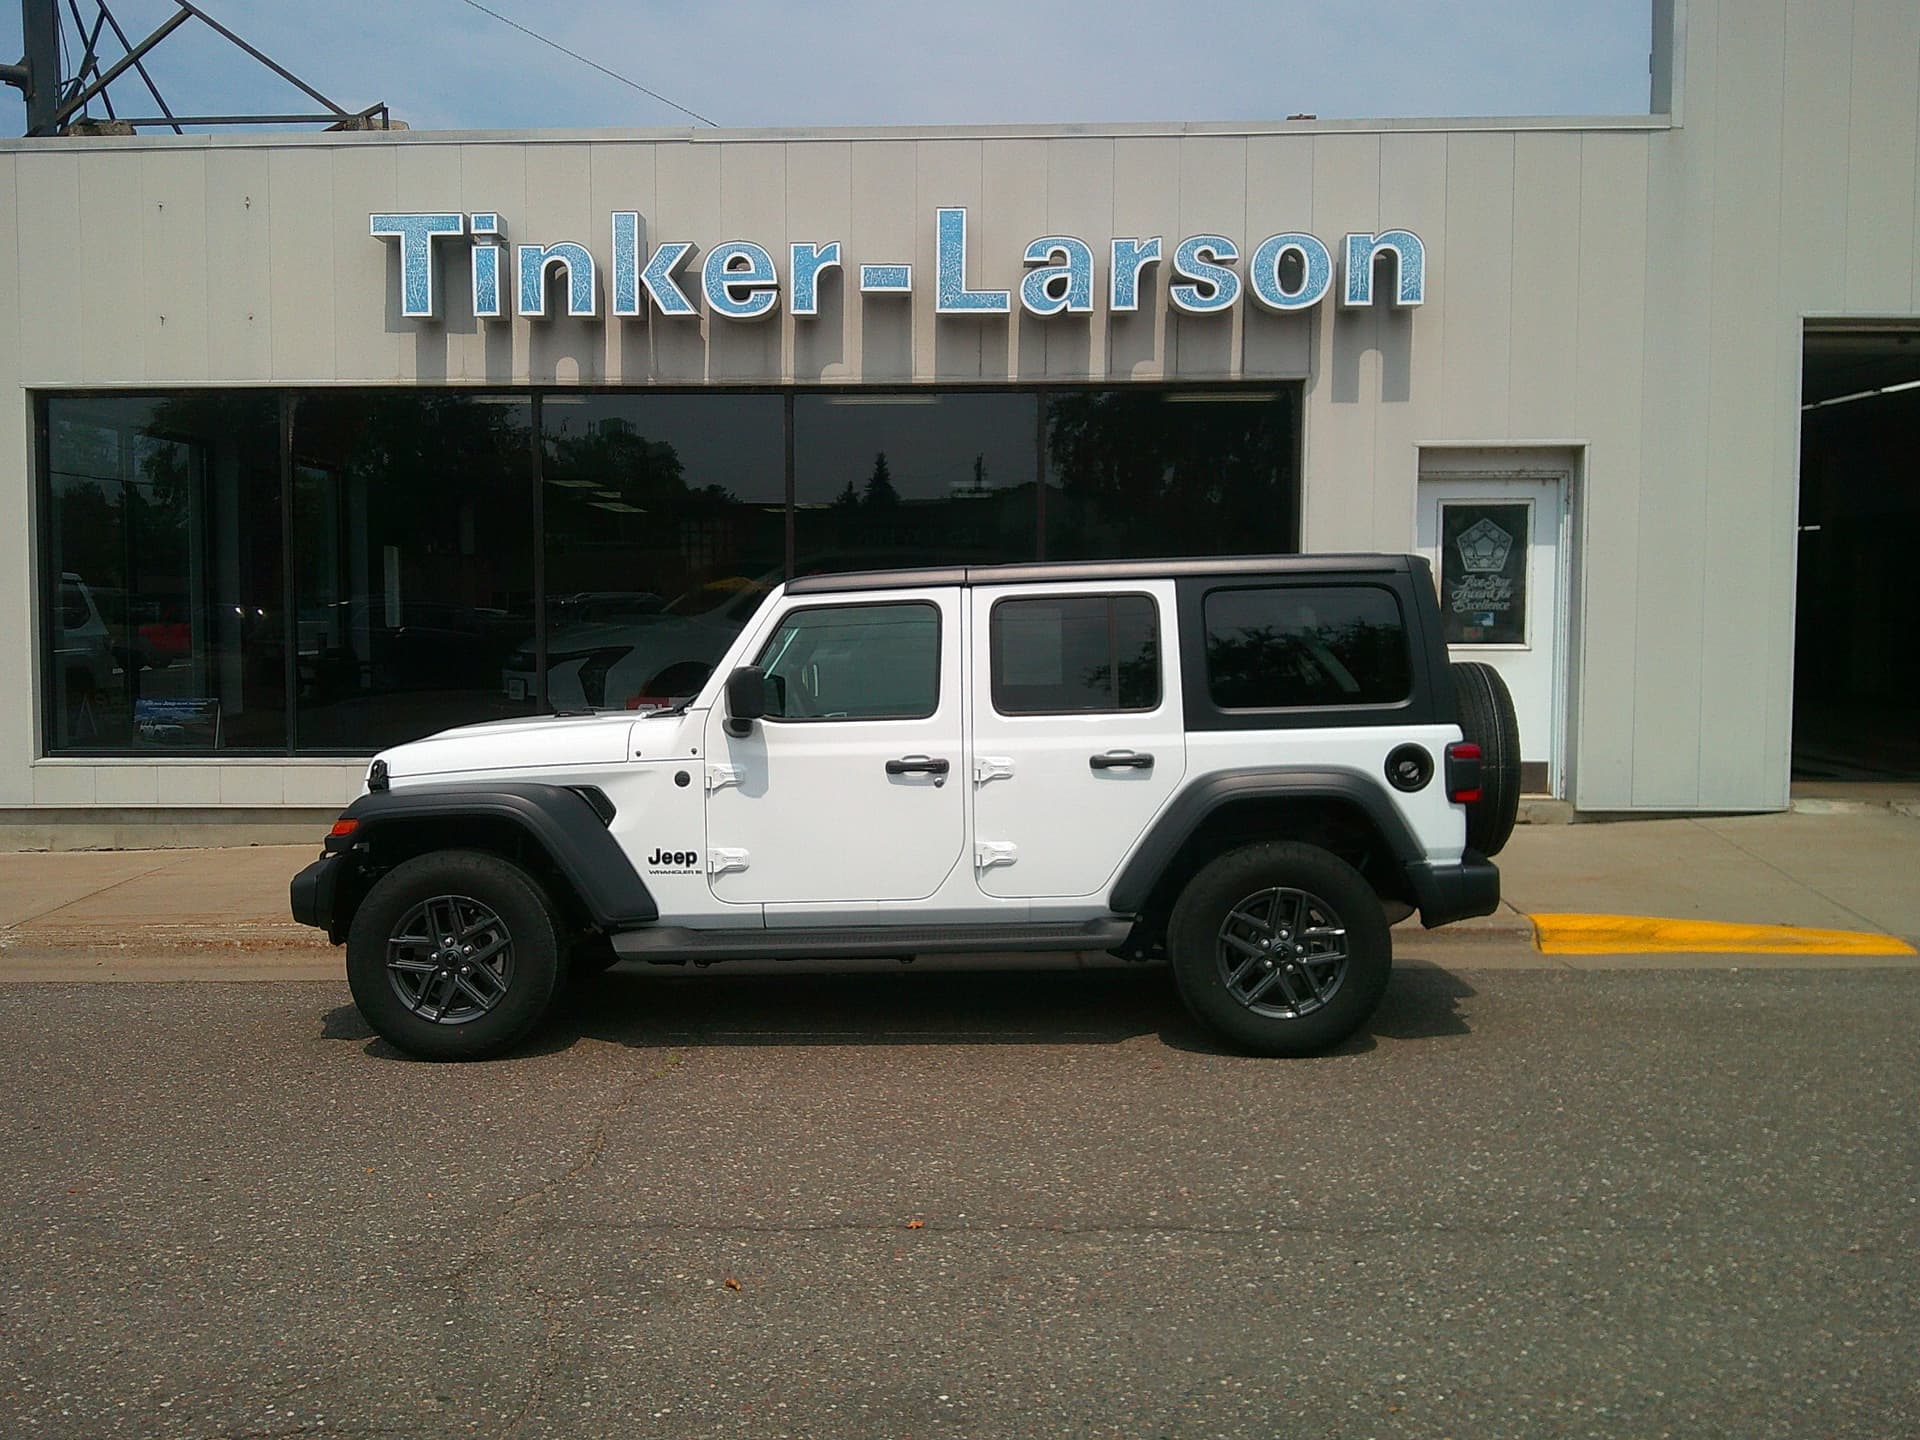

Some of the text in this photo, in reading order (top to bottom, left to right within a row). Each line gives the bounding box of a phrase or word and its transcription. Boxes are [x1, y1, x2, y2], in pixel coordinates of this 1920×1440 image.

[369, 207, 1425, 318] Tinker-Larson
[1452, 600, 1510, 613] Excellence
[648, 848, 698, 868] Jeep
